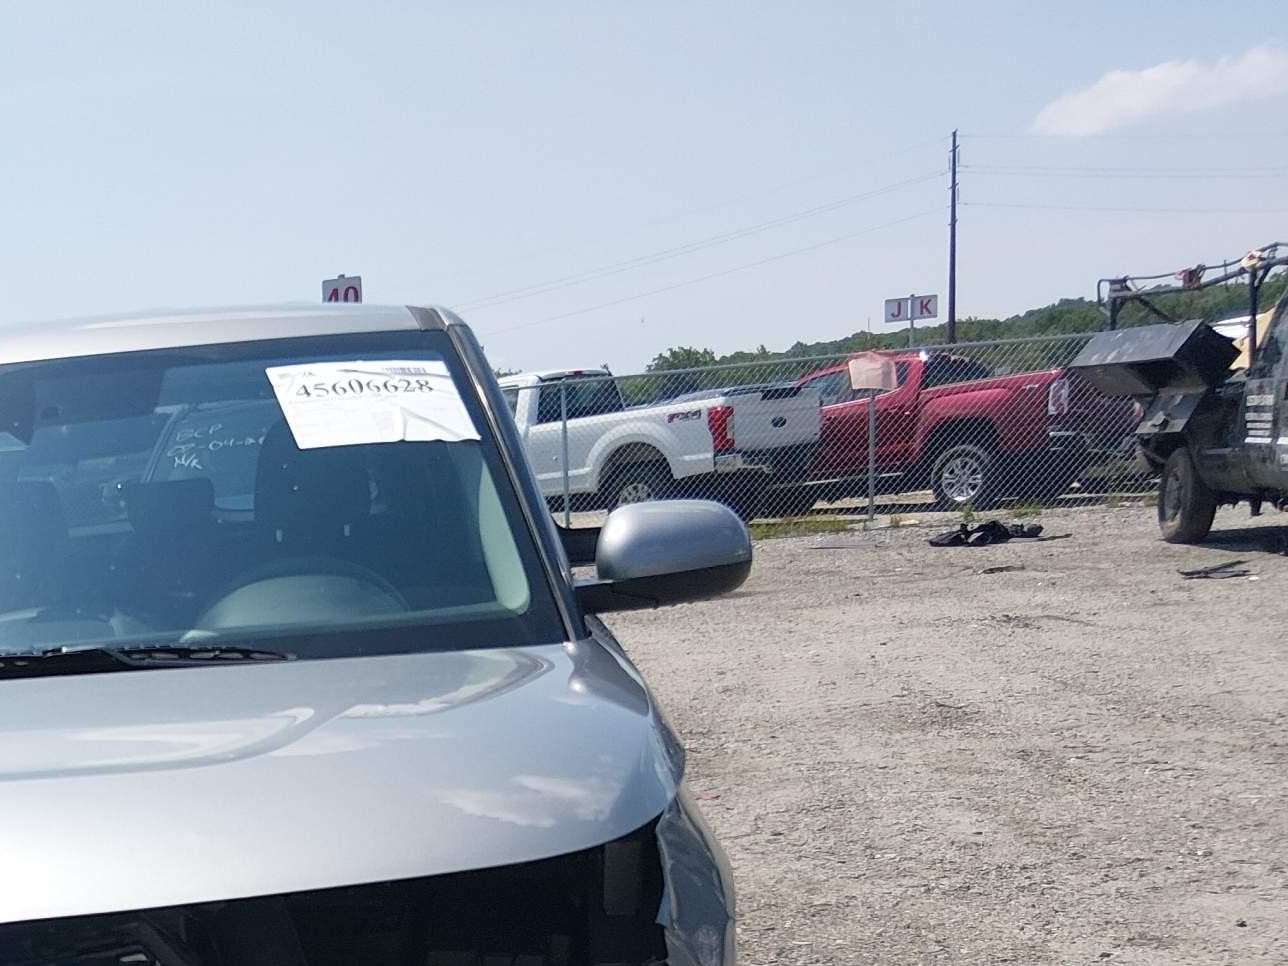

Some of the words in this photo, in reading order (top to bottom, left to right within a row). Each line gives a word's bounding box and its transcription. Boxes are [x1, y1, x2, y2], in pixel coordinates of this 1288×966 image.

[890, 301, 902, 318] J
[919, 298, 933, 316] K
[295, 378, 436, 399] 45606628
